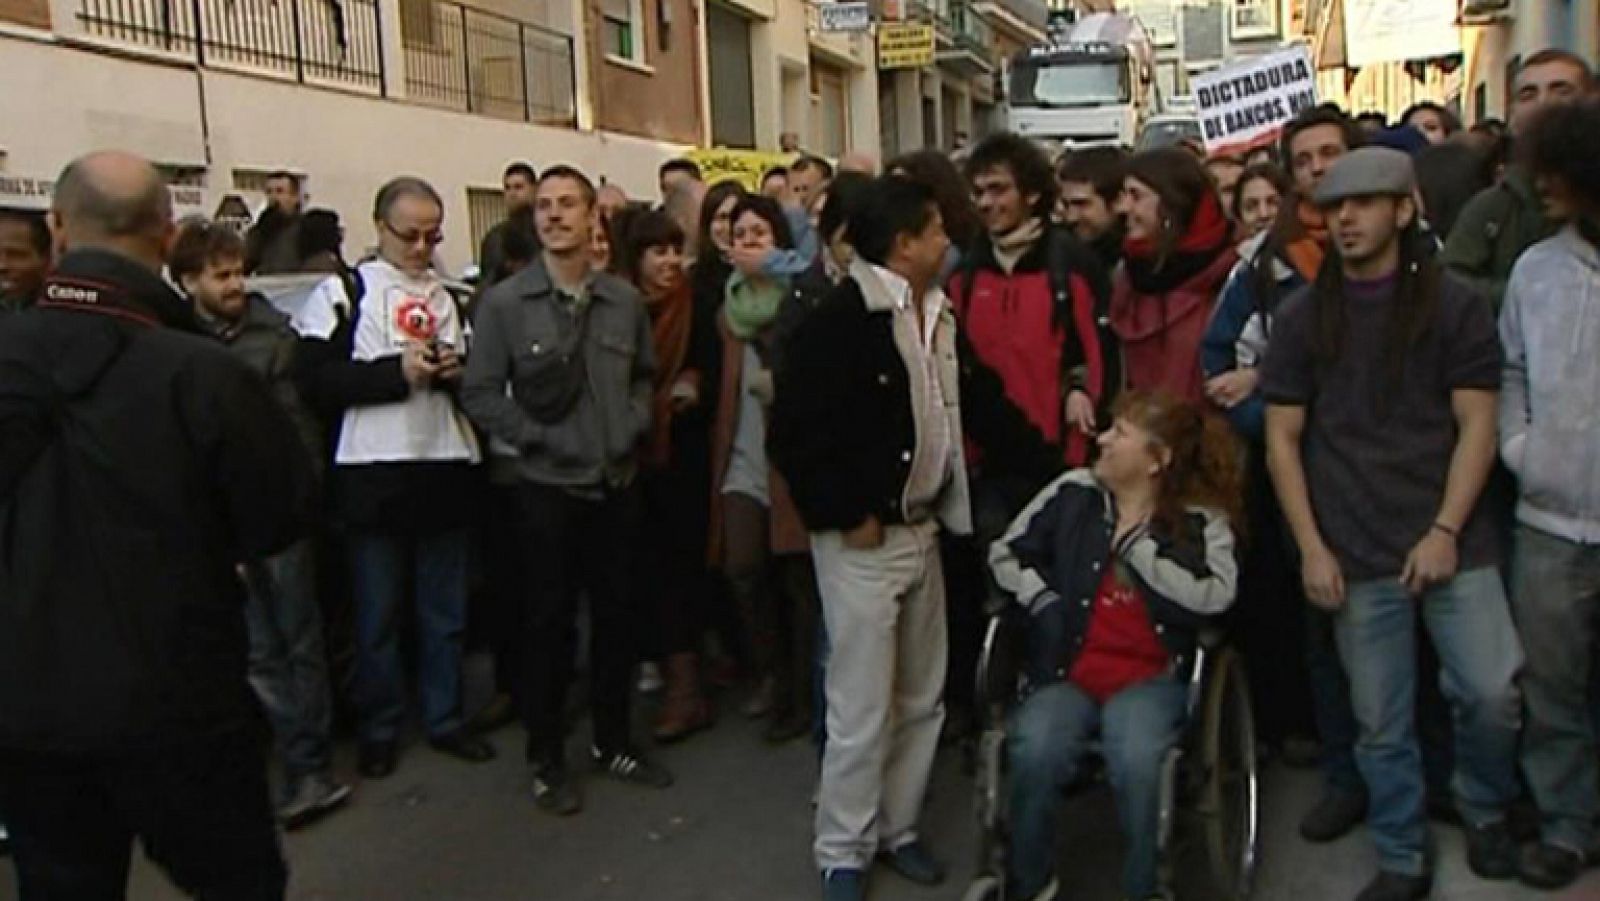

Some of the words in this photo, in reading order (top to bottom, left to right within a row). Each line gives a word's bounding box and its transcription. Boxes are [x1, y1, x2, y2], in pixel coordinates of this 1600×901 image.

[1198, 58, 1309, 109] DICTADURA
[1204, 116, 1224, 139] DE
[47, 285, 99, 303] Canon
